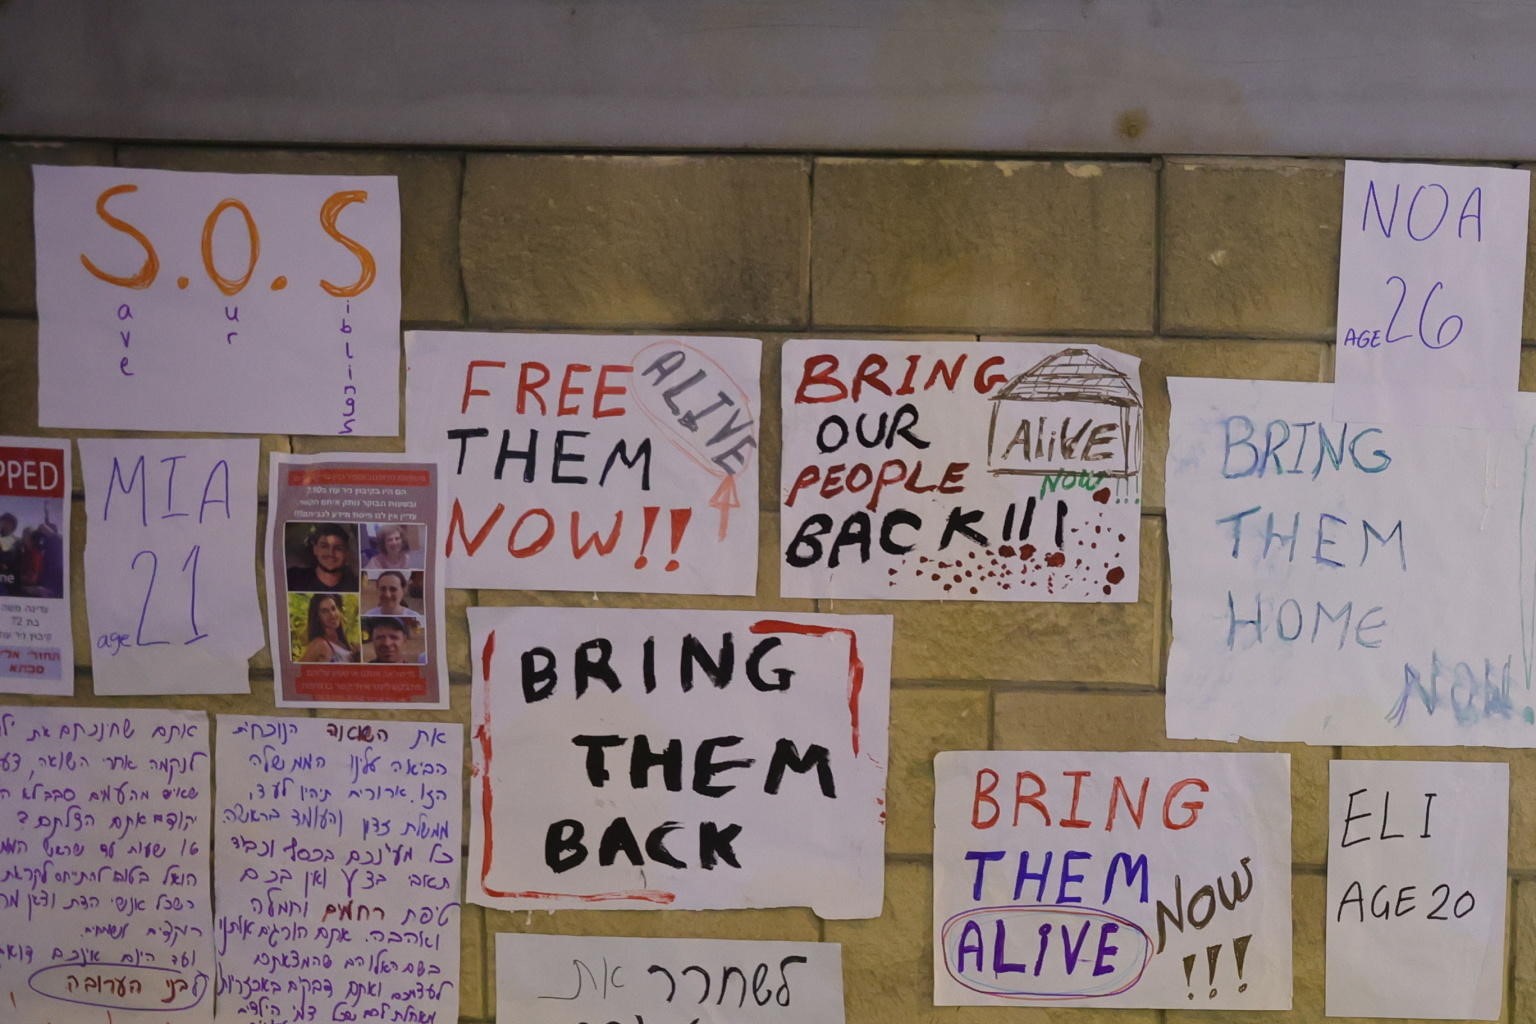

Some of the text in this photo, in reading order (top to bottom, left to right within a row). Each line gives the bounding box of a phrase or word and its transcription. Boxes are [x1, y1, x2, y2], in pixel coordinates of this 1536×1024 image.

[1361, 180, 1482, 242] NOA
[1343, 277, 1463, 349] AGE 26
[459, 358, 635, 419] FREE
[795, 355, 1007, 405] BRING
[642, 350, 758, 476] ALIVE
[816, 404, 929, 454] OUR
[447, 428, 652, 490] THEM
[1219, 416, 1392, 479] BRING
[104, 455, 231, 527] MIA
[785, 461, 968, 511] PEOPLE
[445, 497, 692, 572] NOW!!
[1216, 506, 1407, 571] THEM
[97, 632, 132, 656] age
[132, 545, 208, 646] 21
[1226, 591, 1388, 650] HOME
[522, 632, 795, 702] BRING
[410, 728, 447, 750] את
[572, 735, 837, 798] THEM
[970, 768, 1210, 831] BRING
[1342, 789, 1436, 847] ELI
[545, 817, 742, 873] BACK
[965, 851, 1150, 904] THEM
[1156, 856, 1253, 954] NOW
[1337, 885, 1475, 921] AGE 20
[538, 955, 807, 1008] לשחרר את
